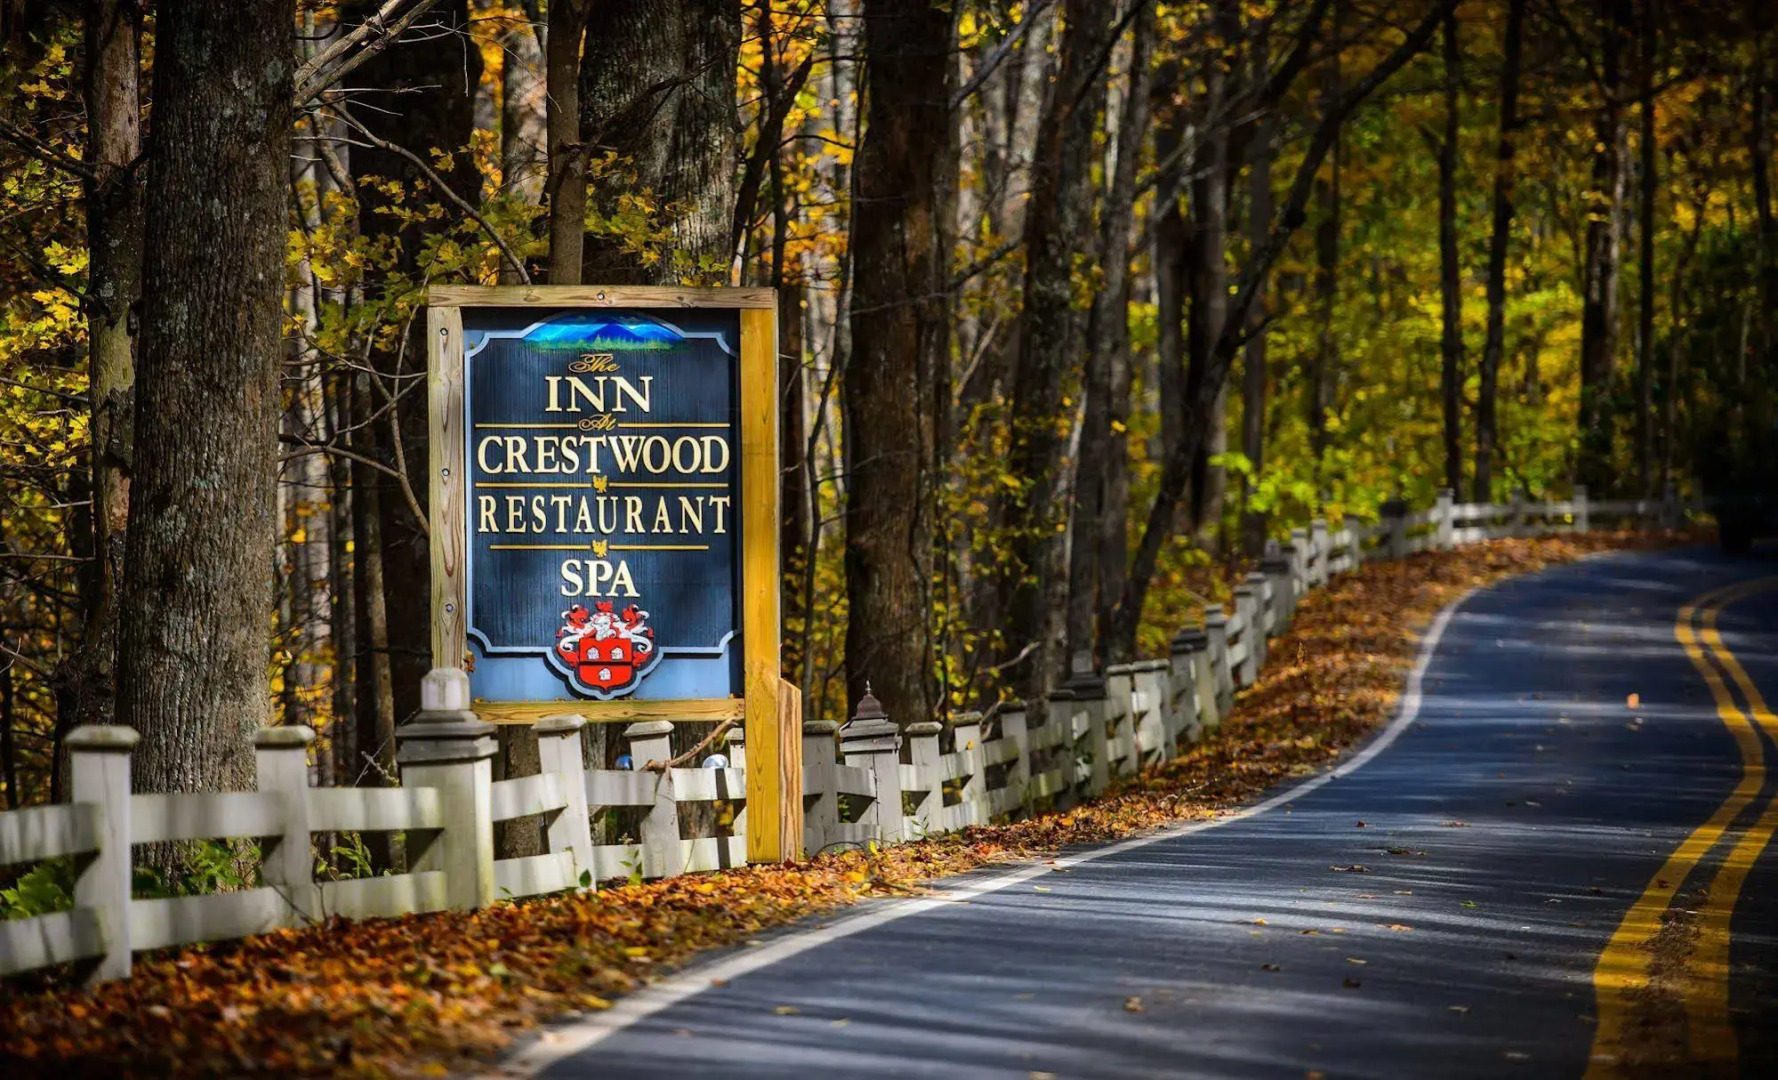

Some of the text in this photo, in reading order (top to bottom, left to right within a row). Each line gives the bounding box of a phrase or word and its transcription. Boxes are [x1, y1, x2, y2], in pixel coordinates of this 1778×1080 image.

[568, 354, 620, 373] The
[544, 376, 653, 412] INN
[578, 413, 617, 431] At
[477, 435, 730, 474] CRESTWOOD
[477, 495, 731, 534] RESTAURANT
[560, 559, 640, 597] SPA
